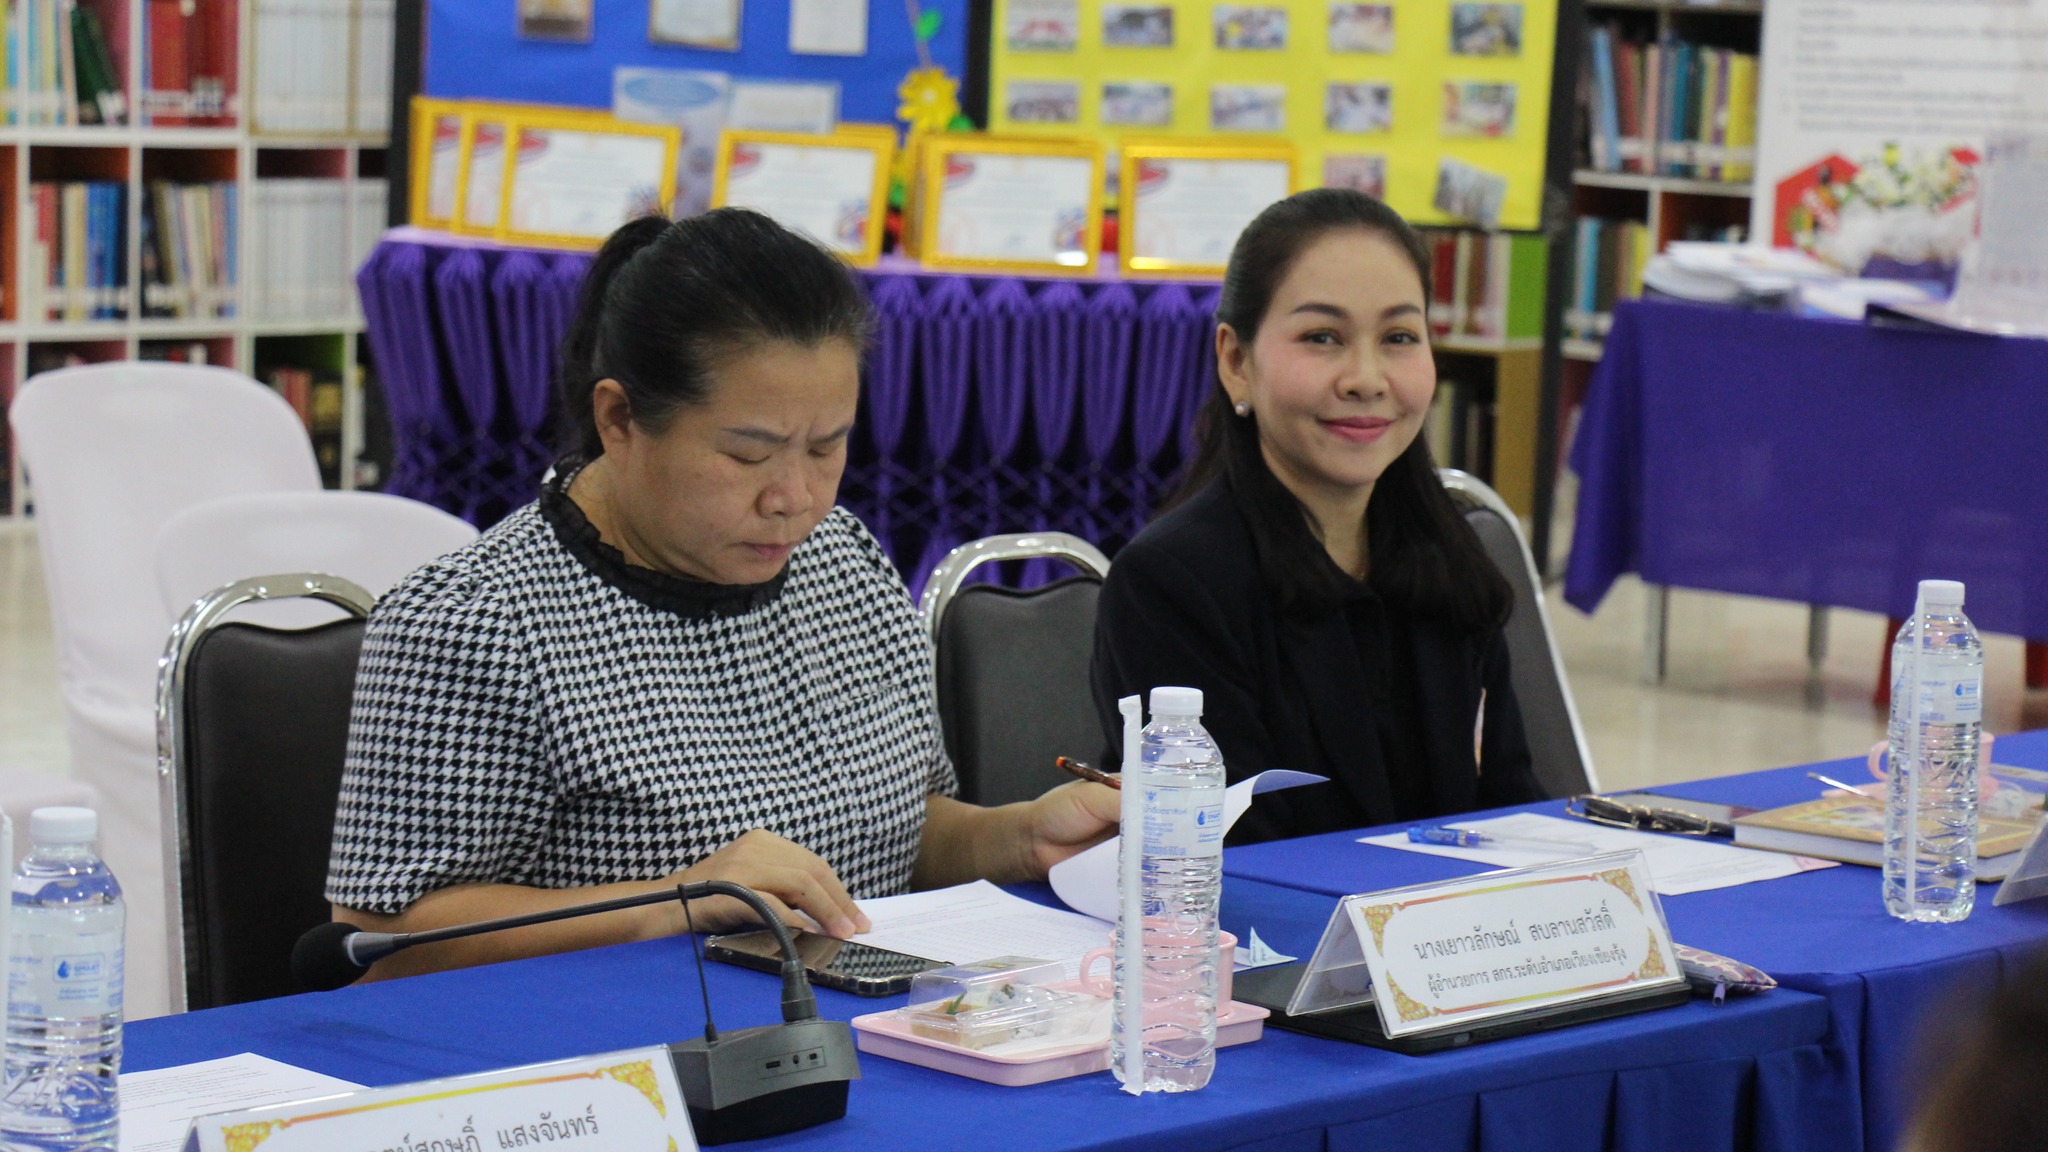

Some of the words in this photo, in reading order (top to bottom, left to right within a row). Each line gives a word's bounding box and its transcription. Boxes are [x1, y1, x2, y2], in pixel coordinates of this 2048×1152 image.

[1413, 918, 1521, 960] นางเยาวลักษณ์
[1528, 899, 1616, 942] สบลานสวัสดิ์
[1427, 971, 1490, 999] ผู้อำนวยการ
[1491, 942, 1628, 983] สกร.ระดับอำเภอเวียงเชียงรุ้ง
[496, 1103, 600, 1149] แสงจันทร์
